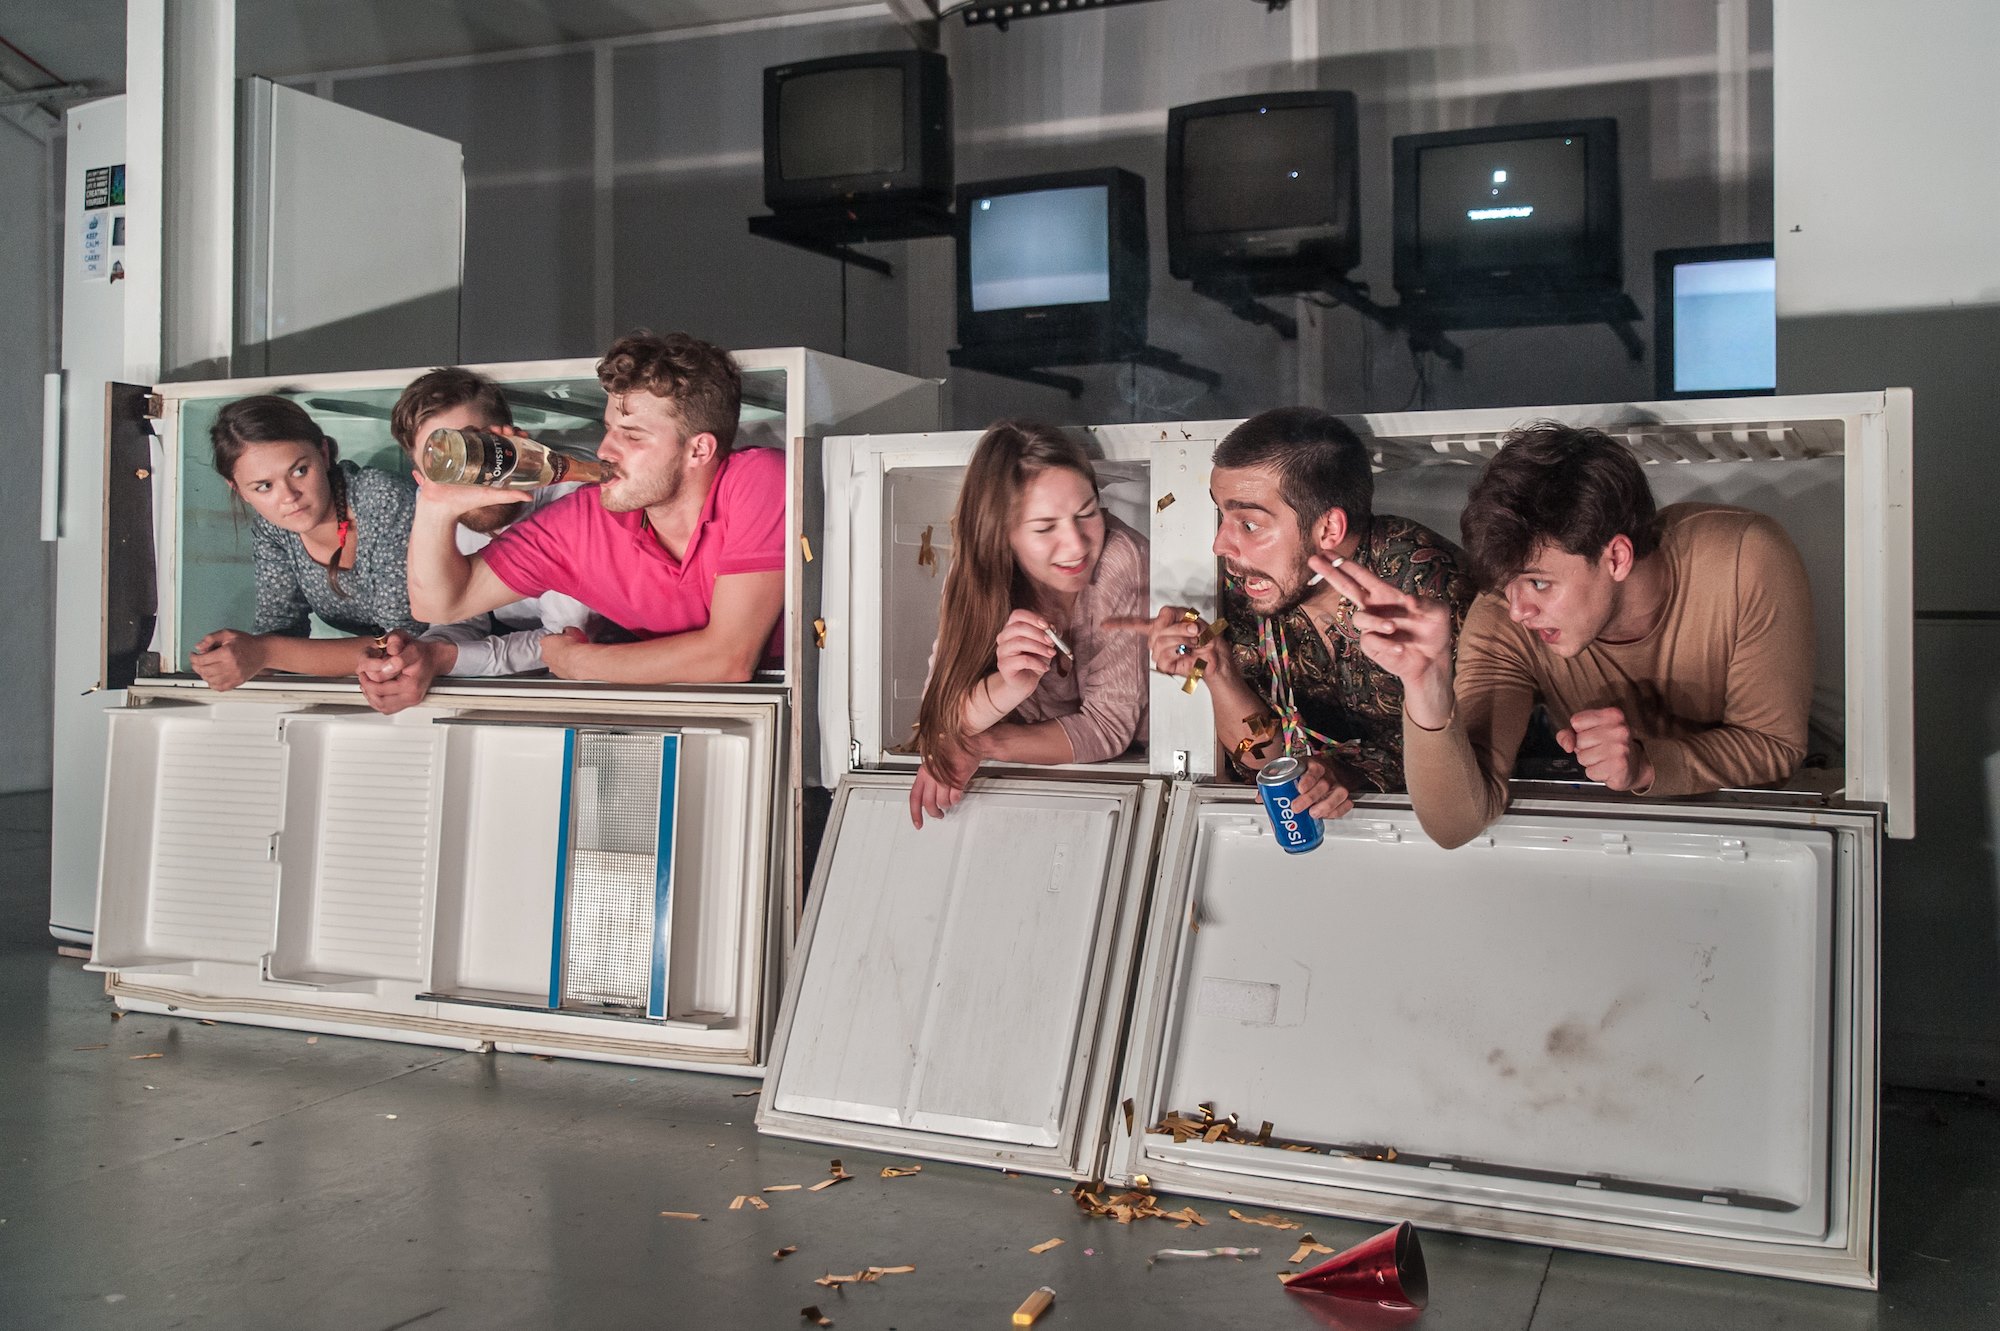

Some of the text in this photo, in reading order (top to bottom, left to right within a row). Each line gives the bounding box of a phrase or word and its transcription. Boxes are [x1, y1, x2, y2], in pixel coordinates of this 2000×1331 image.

[86, 232, 98, 240] KEEP
[85, 240, 99, 248] CALM
[85, 254, 100, 262] CARRY
[1273, 796, 1307, 845] pepsi
